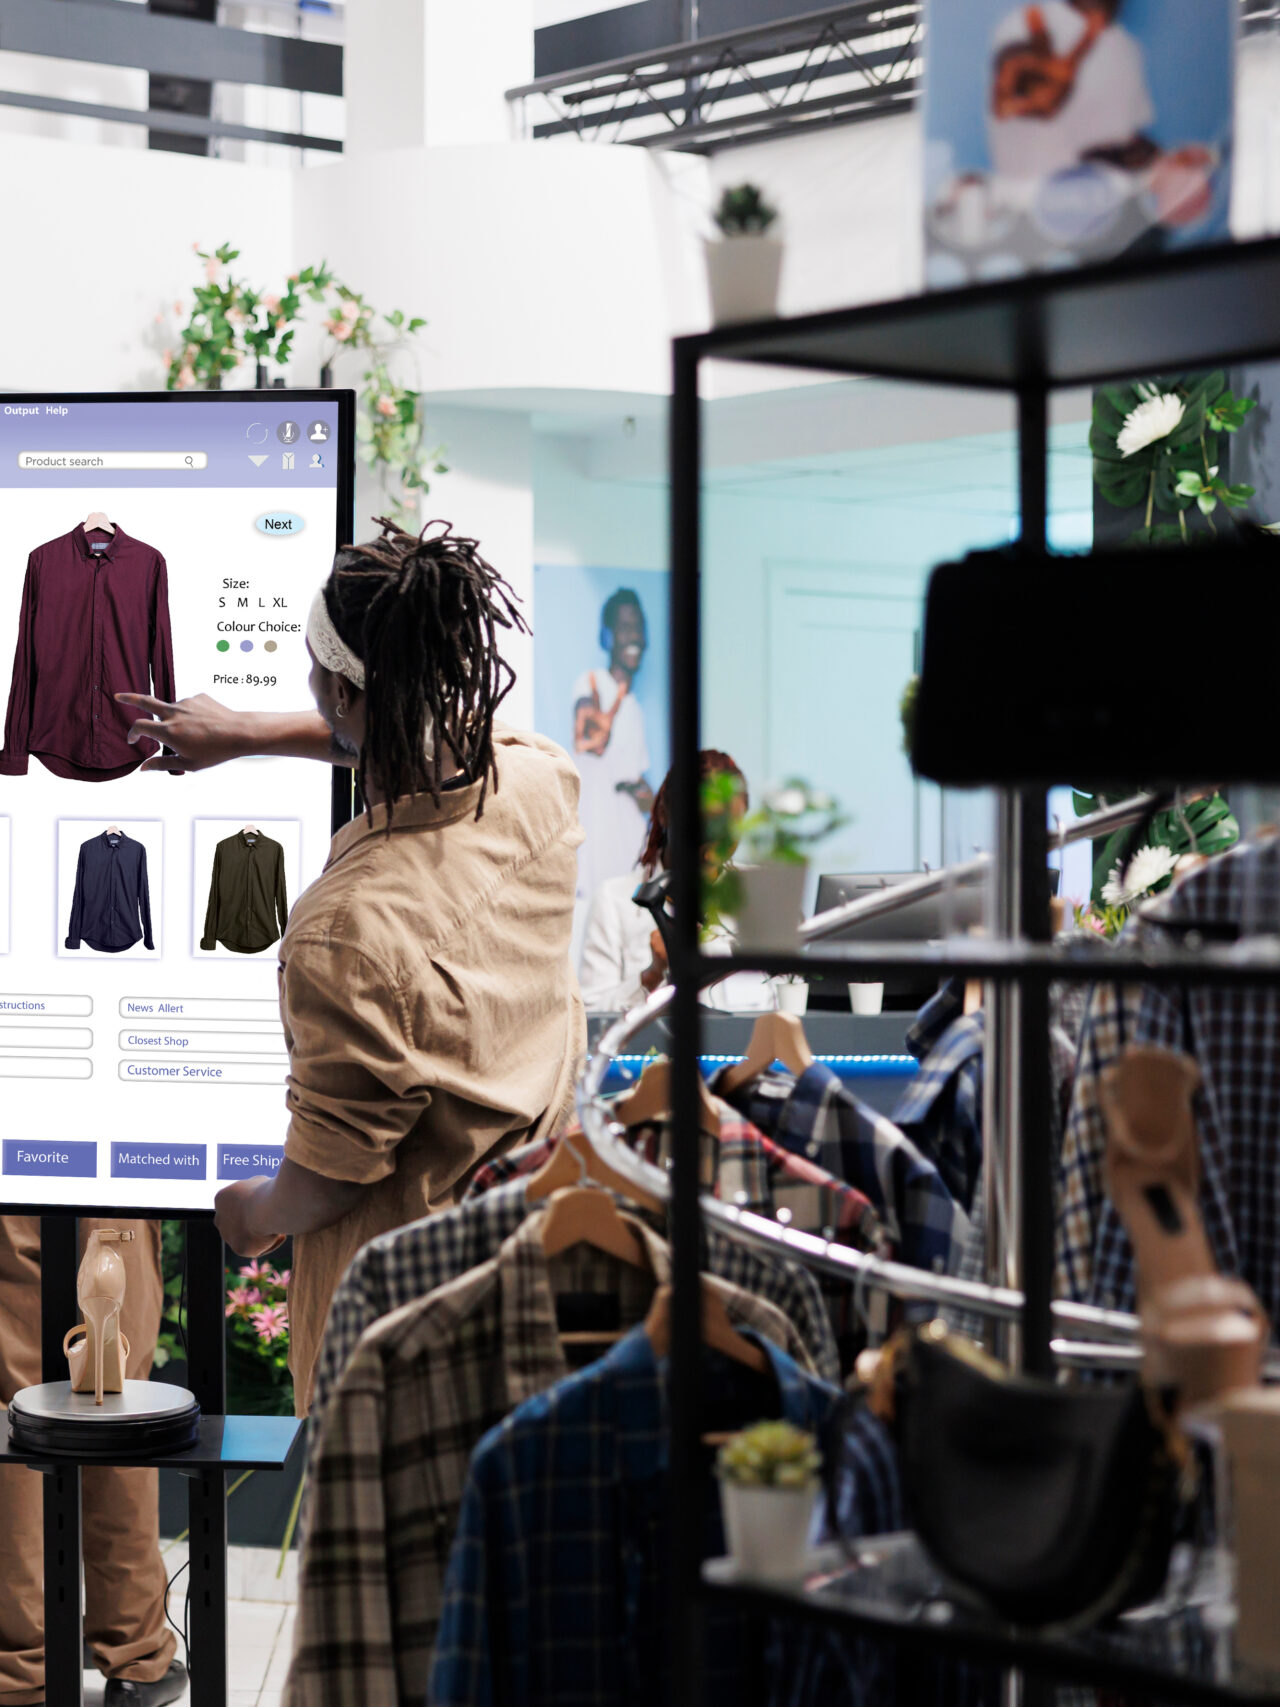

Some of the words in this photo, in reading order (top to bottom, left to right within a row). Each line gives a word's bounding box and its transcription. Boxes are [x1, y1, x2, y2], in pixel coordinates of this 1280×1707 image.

[4, 406, 40, 417] Output
[46, 405, 69, 416] Help
[25, 456, 67, 466] Product
[69, 456, 104, 466] search
[264, 518, 292, 530] Next
[222, 578, 249, 589] Size:
[218, 597, 226, 608] S
[237, 597, 248, 608] M
[258, 597, 265, 608] L
[272, 597, 288, 608] XL
[216, 620, 255, 632] Colour
[258, 620, 301, 632] Choice:
[245, 673, 277, 687] 89.99
[127, 1003, 154, 1013] News
[158, 1003, 184, 1013] Allert
[127, 1035, 162, 1045] Closest
[164, 1036, 189, 1048] Shop
[127, 1064, 181, 1076] Customer
[183, 1066, 223, 1077] Service
[17, 1150, 69, 1164] Favorite
[118, 1152, 170, 1165] Matched
[173, 1154, 200, 1166] with
[223, 1153, 249, 1166] Free
[252, 1154, 283, 1169] Ship
